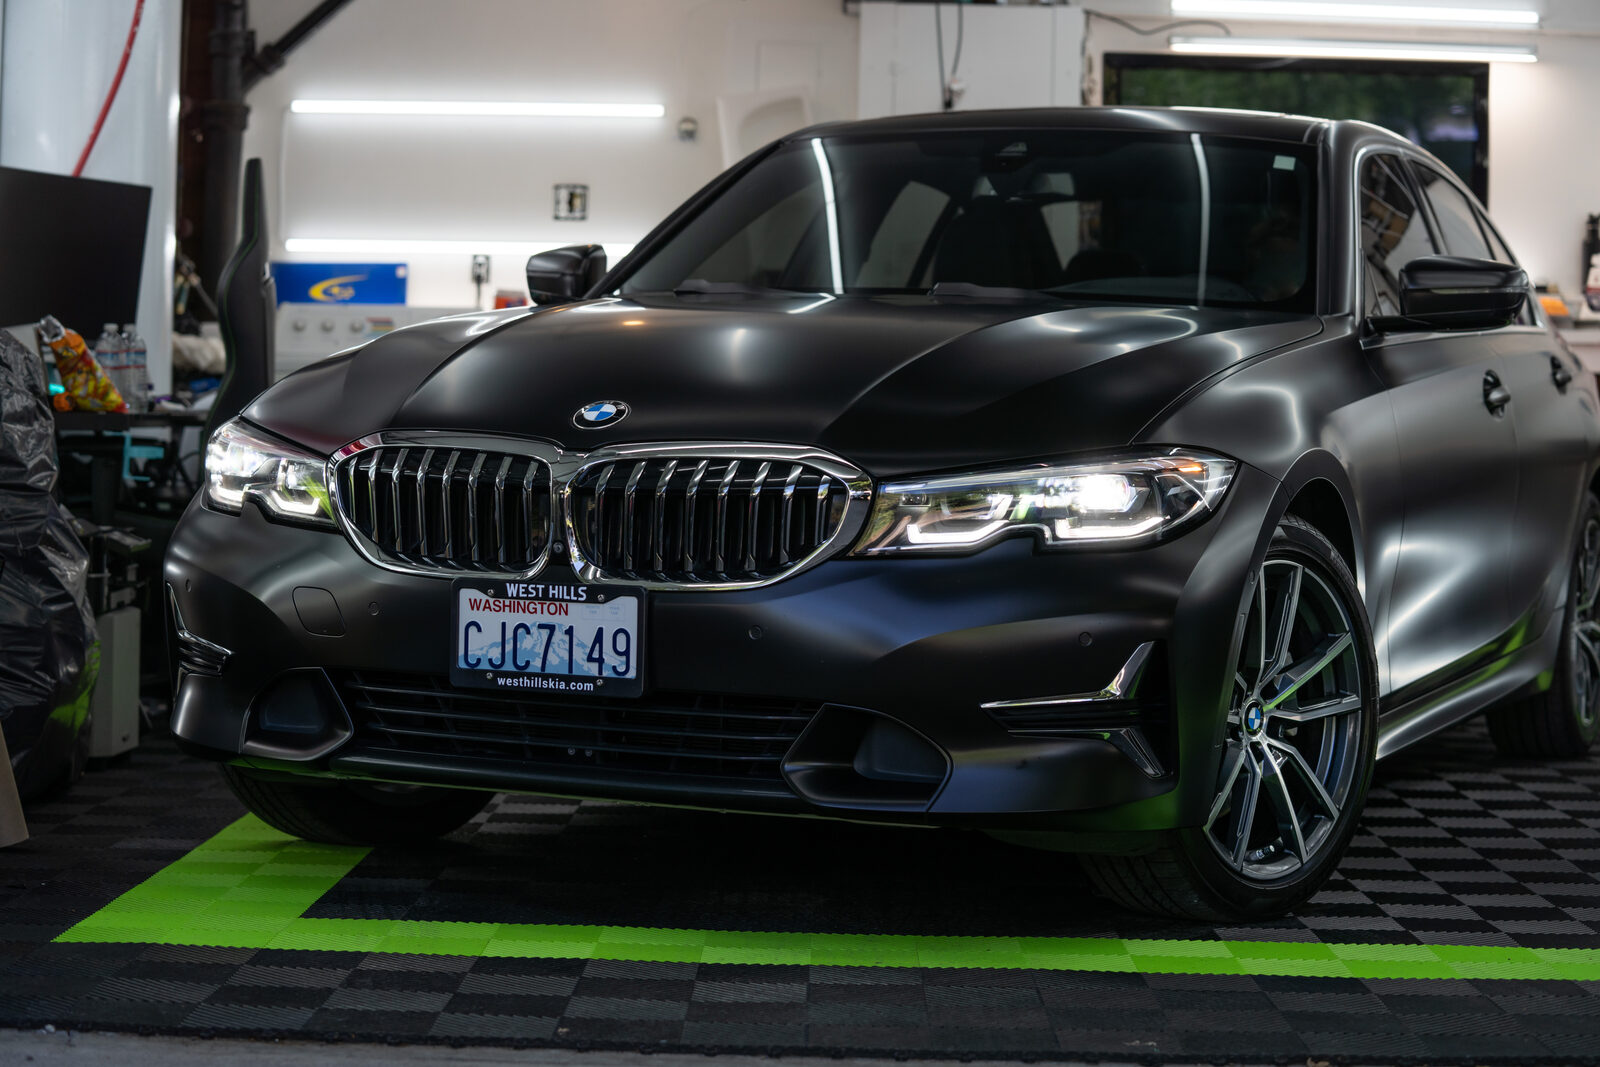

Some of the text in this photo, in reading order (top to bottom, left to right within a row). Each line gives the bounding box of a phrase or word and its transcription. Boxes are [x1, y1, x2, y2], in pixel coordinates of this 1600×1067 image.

[506, 583, 587, 601] WEST HILLS
[468, 598, 569, 616] WASHINGTON
[463, 620, 631, 676] CJC7149
[497, 676, 594, 691] westhillskia.com
